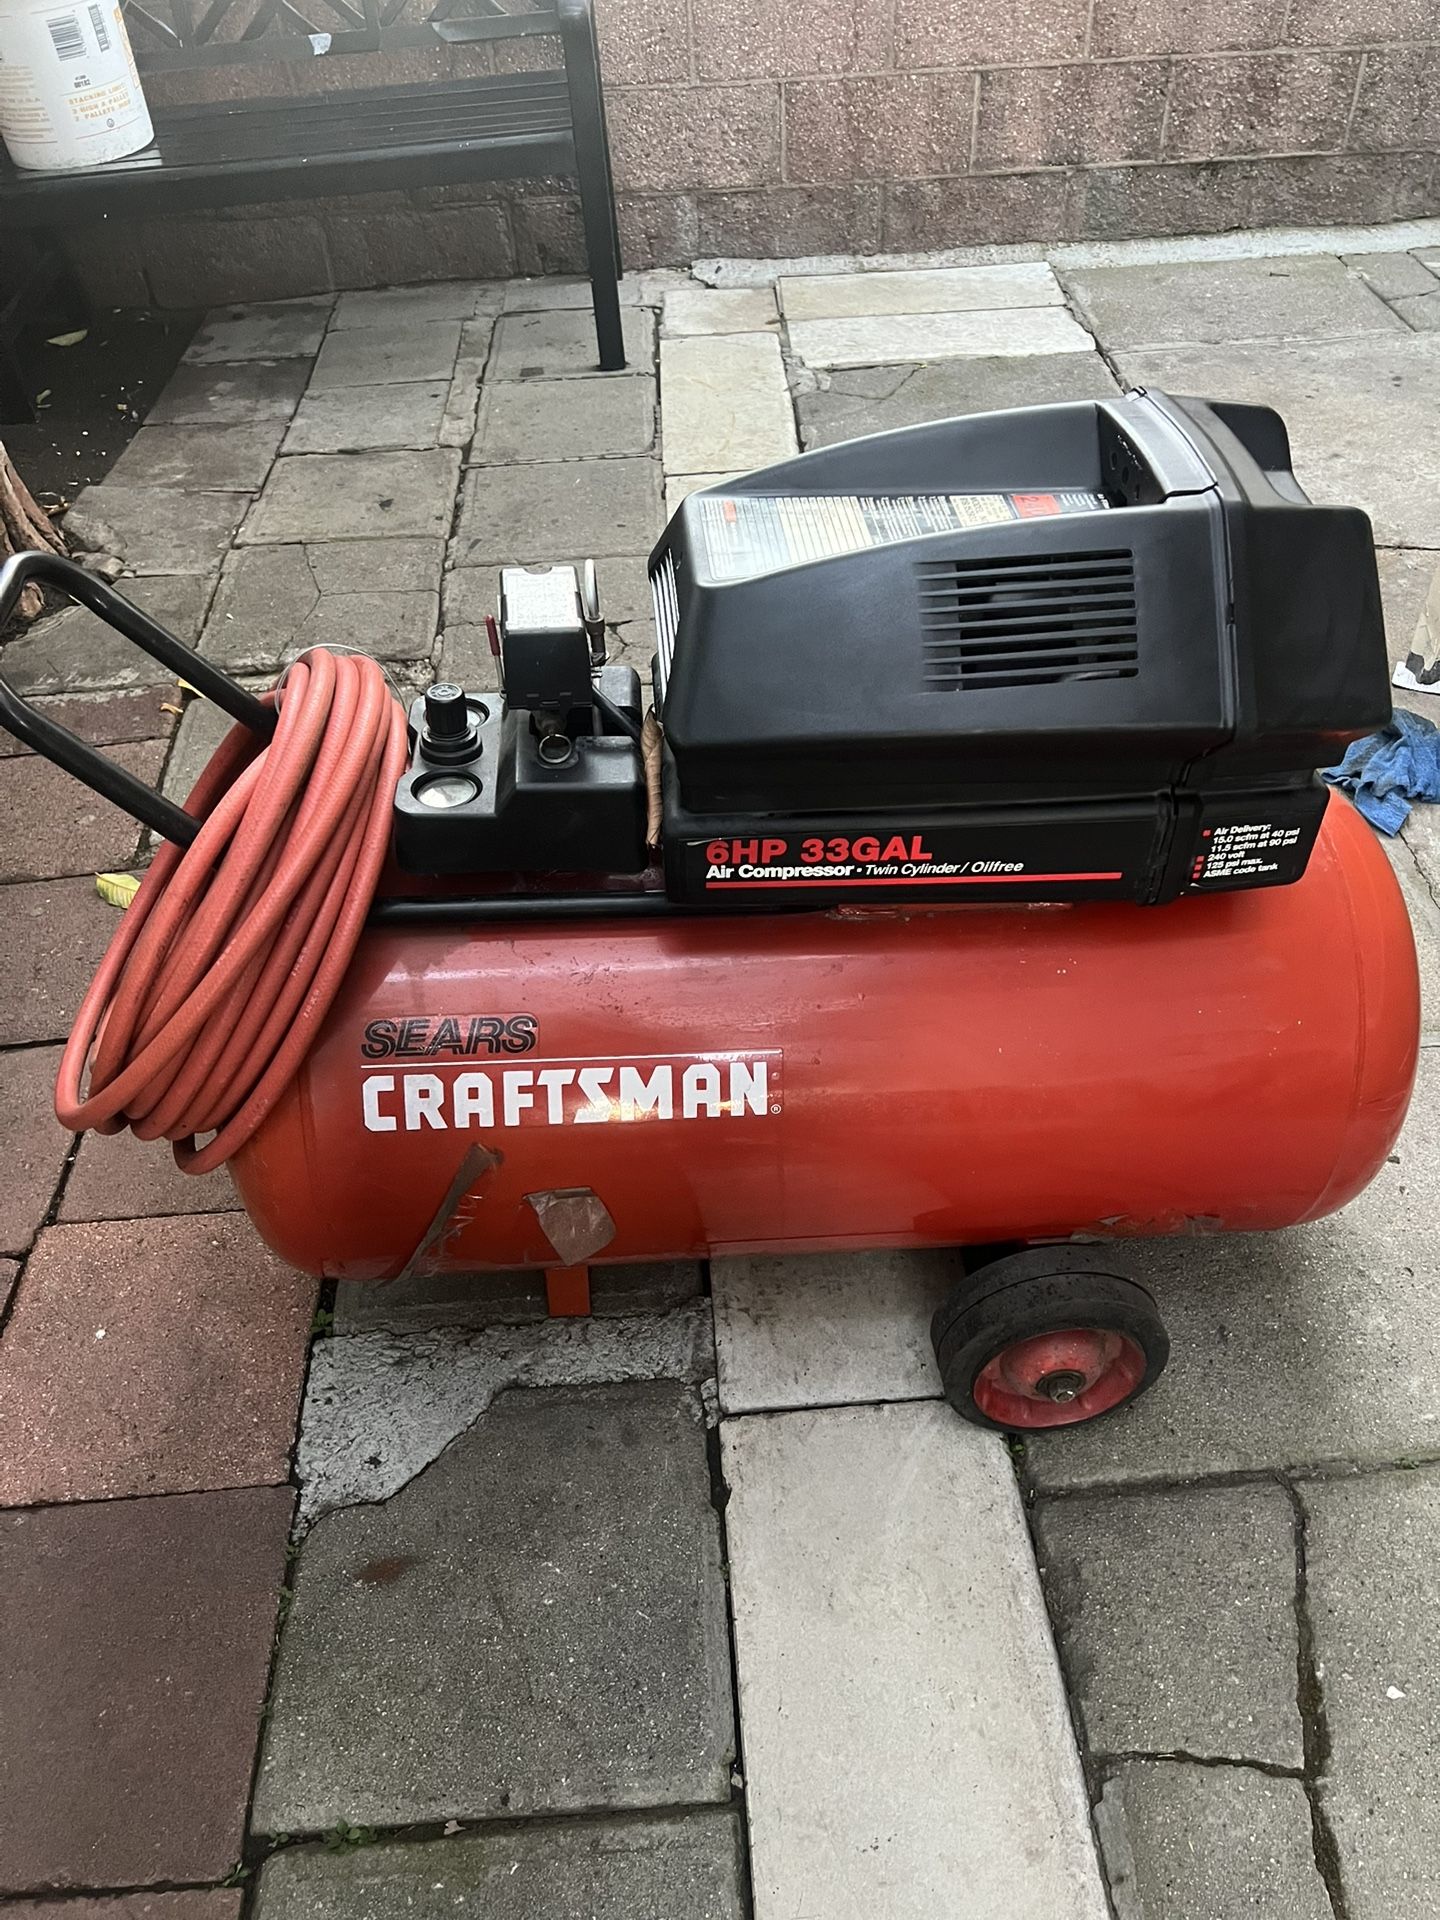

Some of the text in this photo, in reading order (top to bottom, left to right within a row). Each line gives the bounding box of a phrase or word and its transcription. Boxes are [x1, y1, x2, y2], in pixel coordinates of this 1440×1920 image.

[69, 90, 106, 104] STACKING
[84, 106, 115, 119] PALLETS
[1213, 836, 1234, 844] 15.0
[1234, 833, 1259, 842] scfm
[1272, 830, 1284, 838] 40
[1285, 828, 1300, 838] psi
[1214, 824, 1272, 836] Air Delivery:
[706, 835, 933, 864] 6HP 33GAL
[1211, 844, 1232, 853] 11.5
[1232, 841, 1256, 851] scfm
[1269, 838, 1282, 846] 90
[1282, 836, 1298, 847] psi
[1206, 857, 1263, 870] 125 psi max.
[1208, 851, 1246, 862] 240 volt
[706, 864, 732, 880] Air
[738, 864, 854, 881] Compressor
[866, 864, 898, 876] Twin
[971, 861, 1024, 872] Oilfree
[1202, 862, 1278, 879] ASME code tank
[361, 1014, 538, 1058] SEARS
[362, 1061, 769, 1132] CRAFTSMAN
